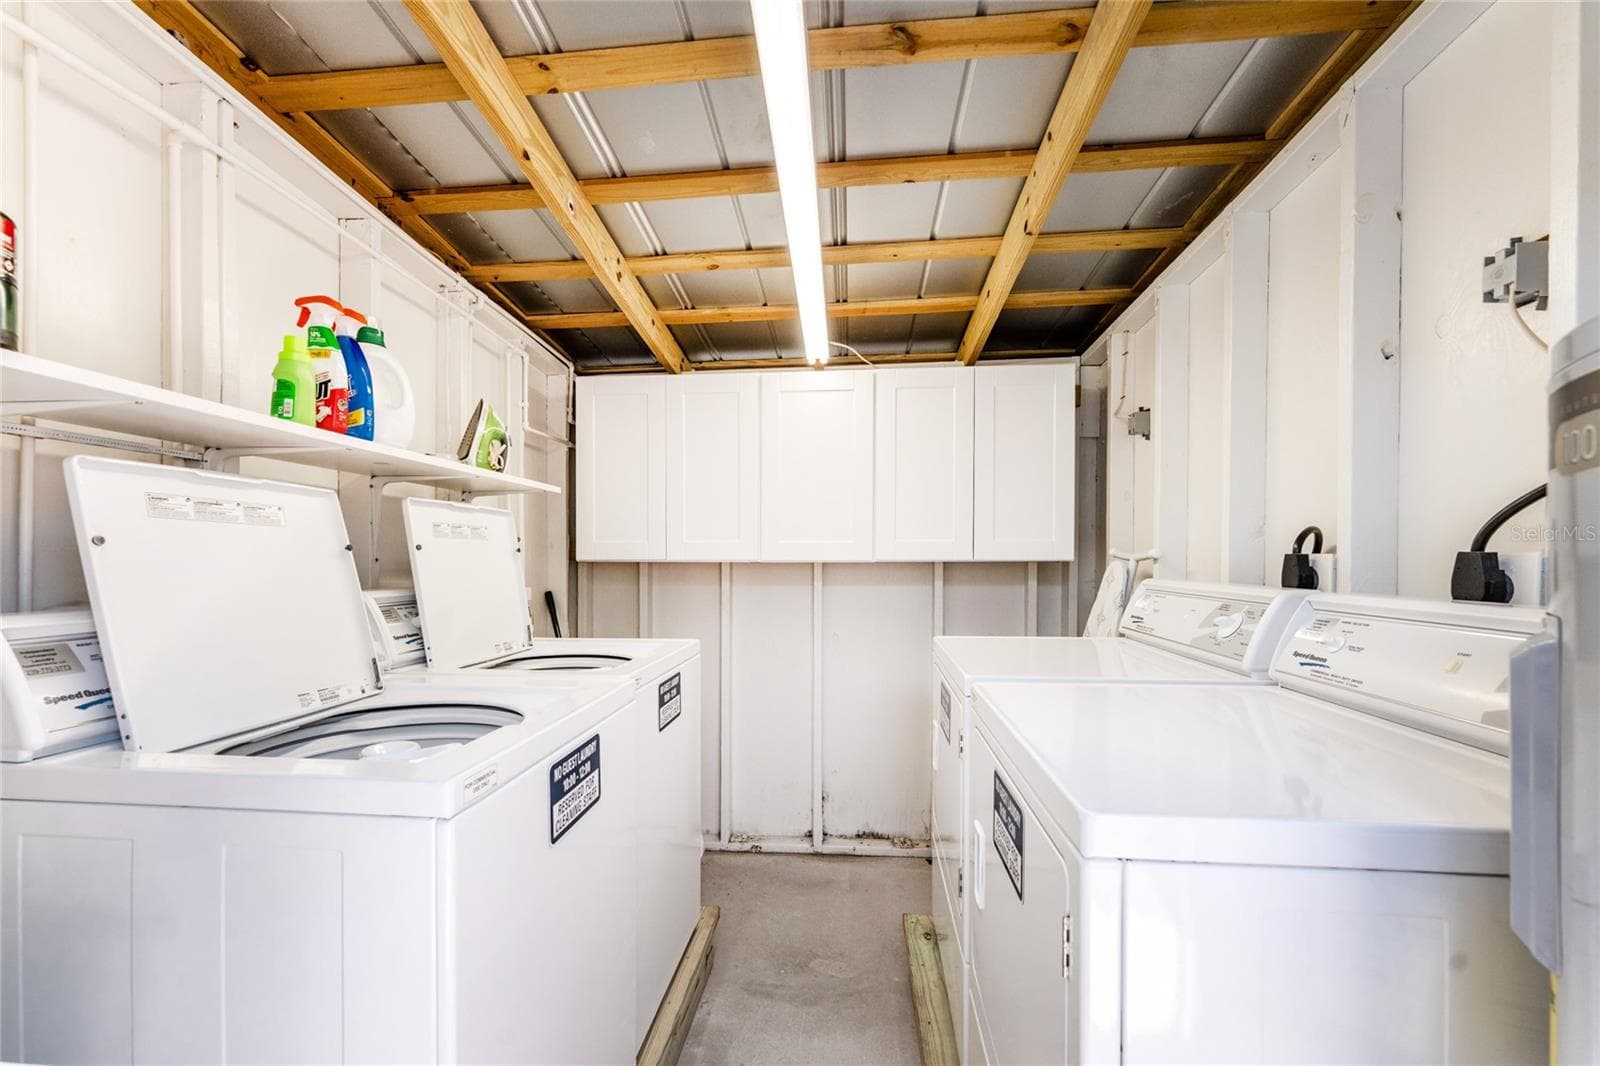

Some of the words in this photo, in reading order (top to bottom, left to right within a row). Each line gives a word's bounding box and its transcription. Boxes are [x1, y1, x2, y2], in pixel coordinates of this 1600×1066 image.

[43, 690, 83, 705] Speed
[83, 687, 111, 698] Quee
[553, 765, 563, 783] NO
[562, 753, 578, 776] GUEST
[577, 740, 598, 764] LAUNDRY
[555, 799, 582, 833] CLEANING
[582, 784, 598, 808] STAFF
[557, 784, 584, 817] RESERVED
[585, 775, 595, 794] FOR
